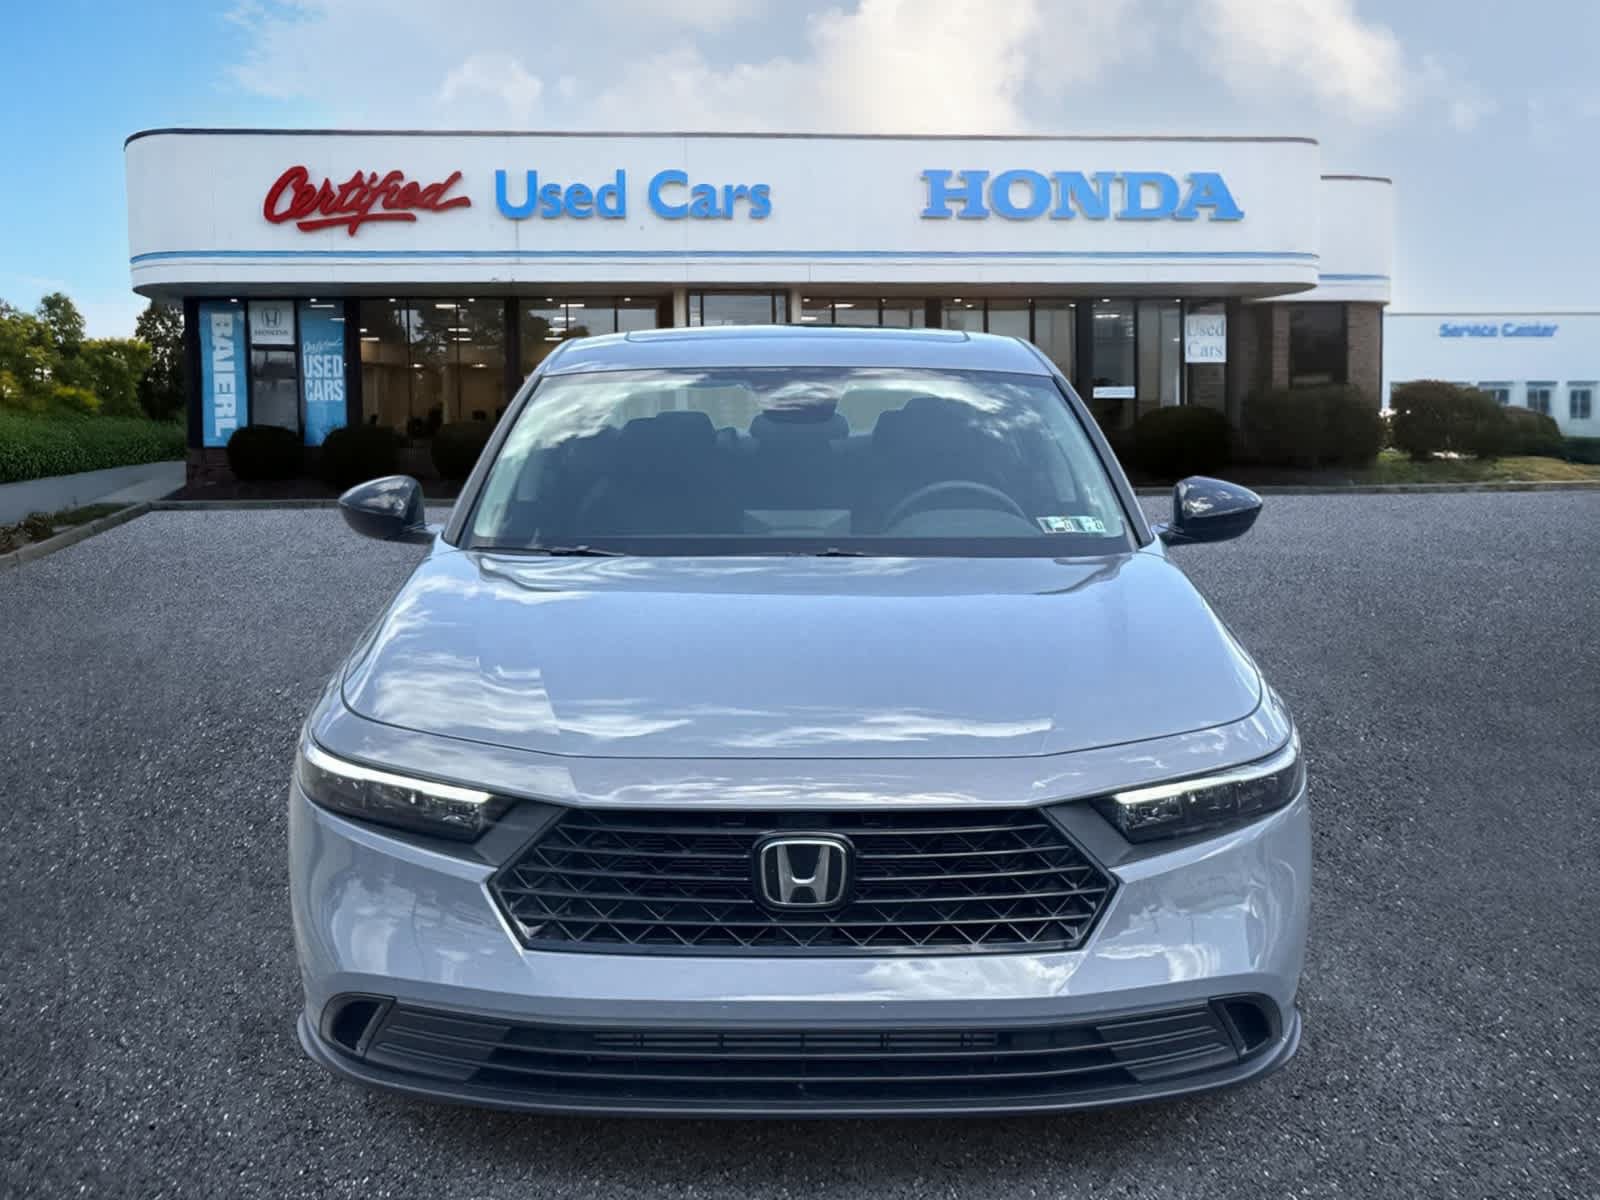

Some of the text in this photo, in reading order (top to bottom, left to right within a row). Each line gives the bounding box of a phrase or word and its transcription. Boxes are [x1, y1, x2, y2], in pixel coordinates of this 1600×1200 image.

[263, 165, 773, 237] Certified Used Cars
[920, 169, 1245, 221] HONDA
[1187, 319, 1225, 337] Used
[1187, 340, 1224, 358] Cars
[210, 312, 237, 438] BAIERL
[303, 354, 344, 378] USED
[304, 379, 345, 402] CARS
